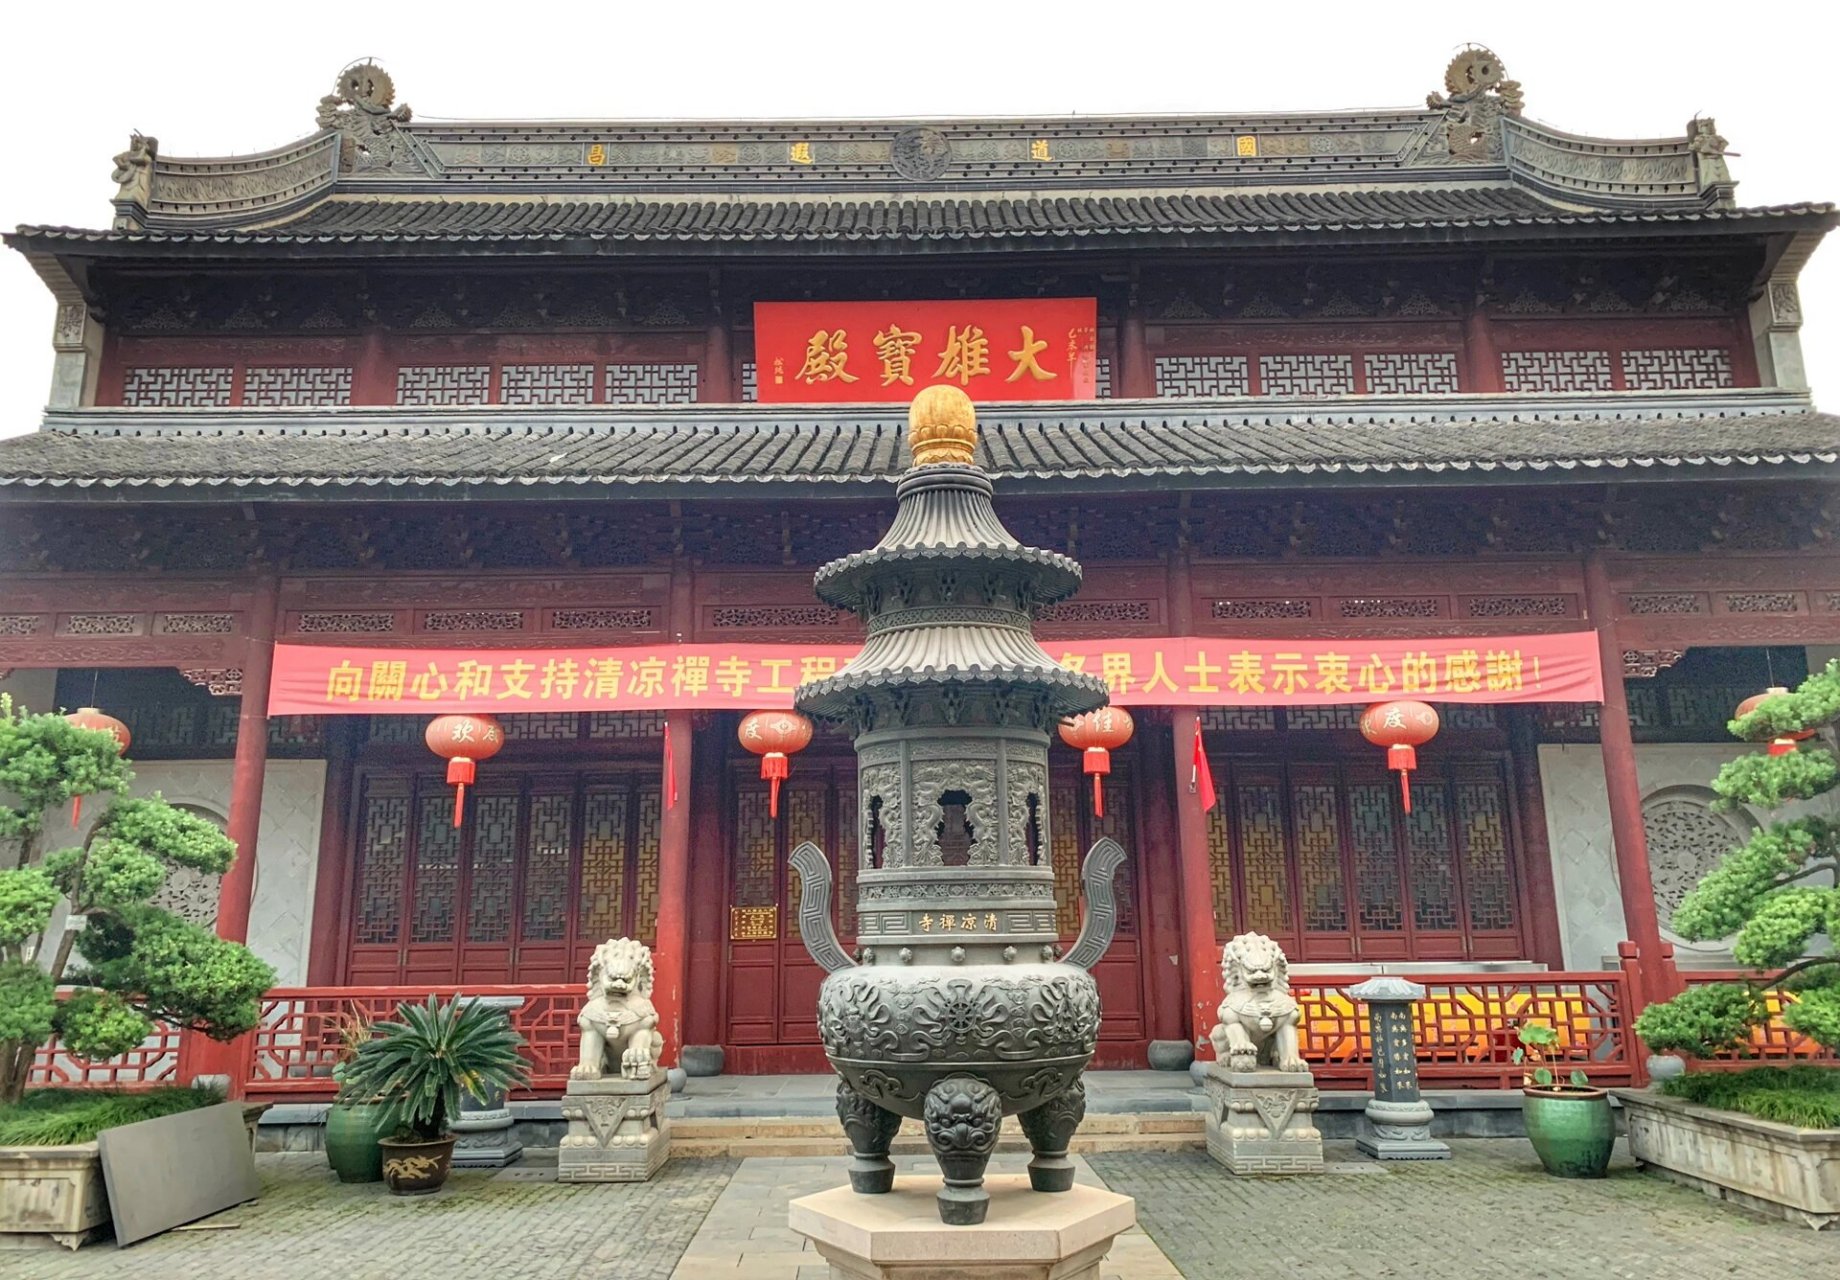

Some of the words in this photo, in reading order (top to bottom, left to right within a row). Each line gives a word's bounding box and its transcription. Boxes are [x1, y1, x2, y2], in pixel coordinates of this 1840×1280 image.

[1031, 140, 1055, 161] 道
[795, 324, 1057, 387] 大雄寶殿
[327, 655, 854, 702] 向關心和支持清凉禪寺工程
